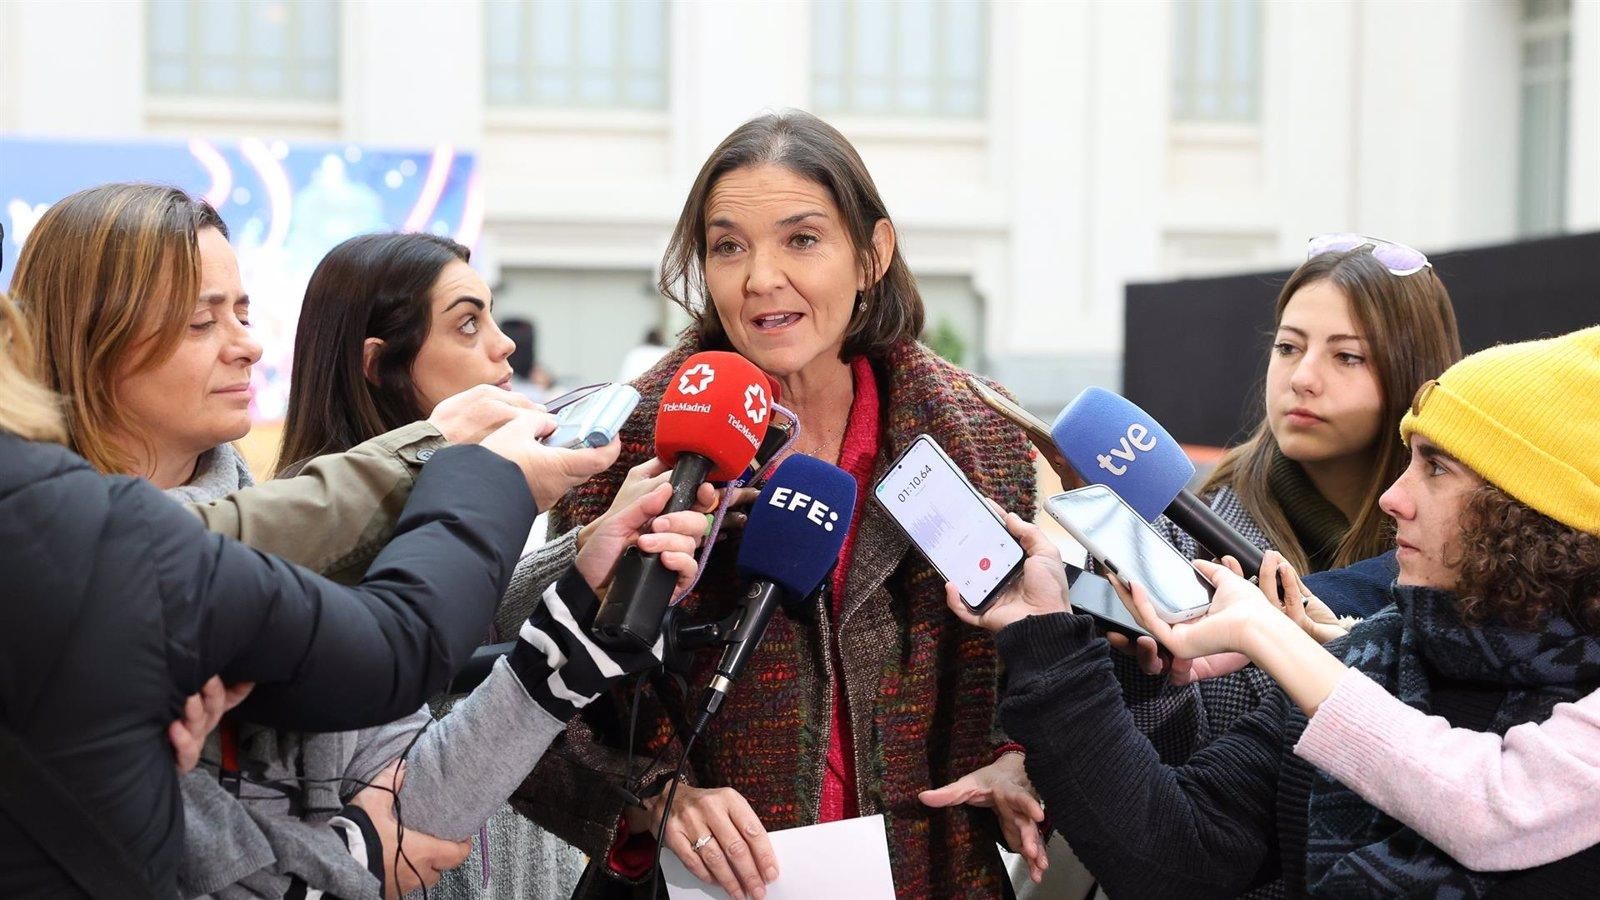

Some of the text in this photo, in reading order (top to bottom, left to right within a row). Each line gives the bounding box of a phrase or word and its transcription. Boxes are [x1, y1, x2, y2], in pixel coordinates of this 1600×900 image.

[663, 402, 711, 413] TeleMadrid
[1096, 423, 1157, 476] tve
[897, 464, 932, 503] 01:10.64
